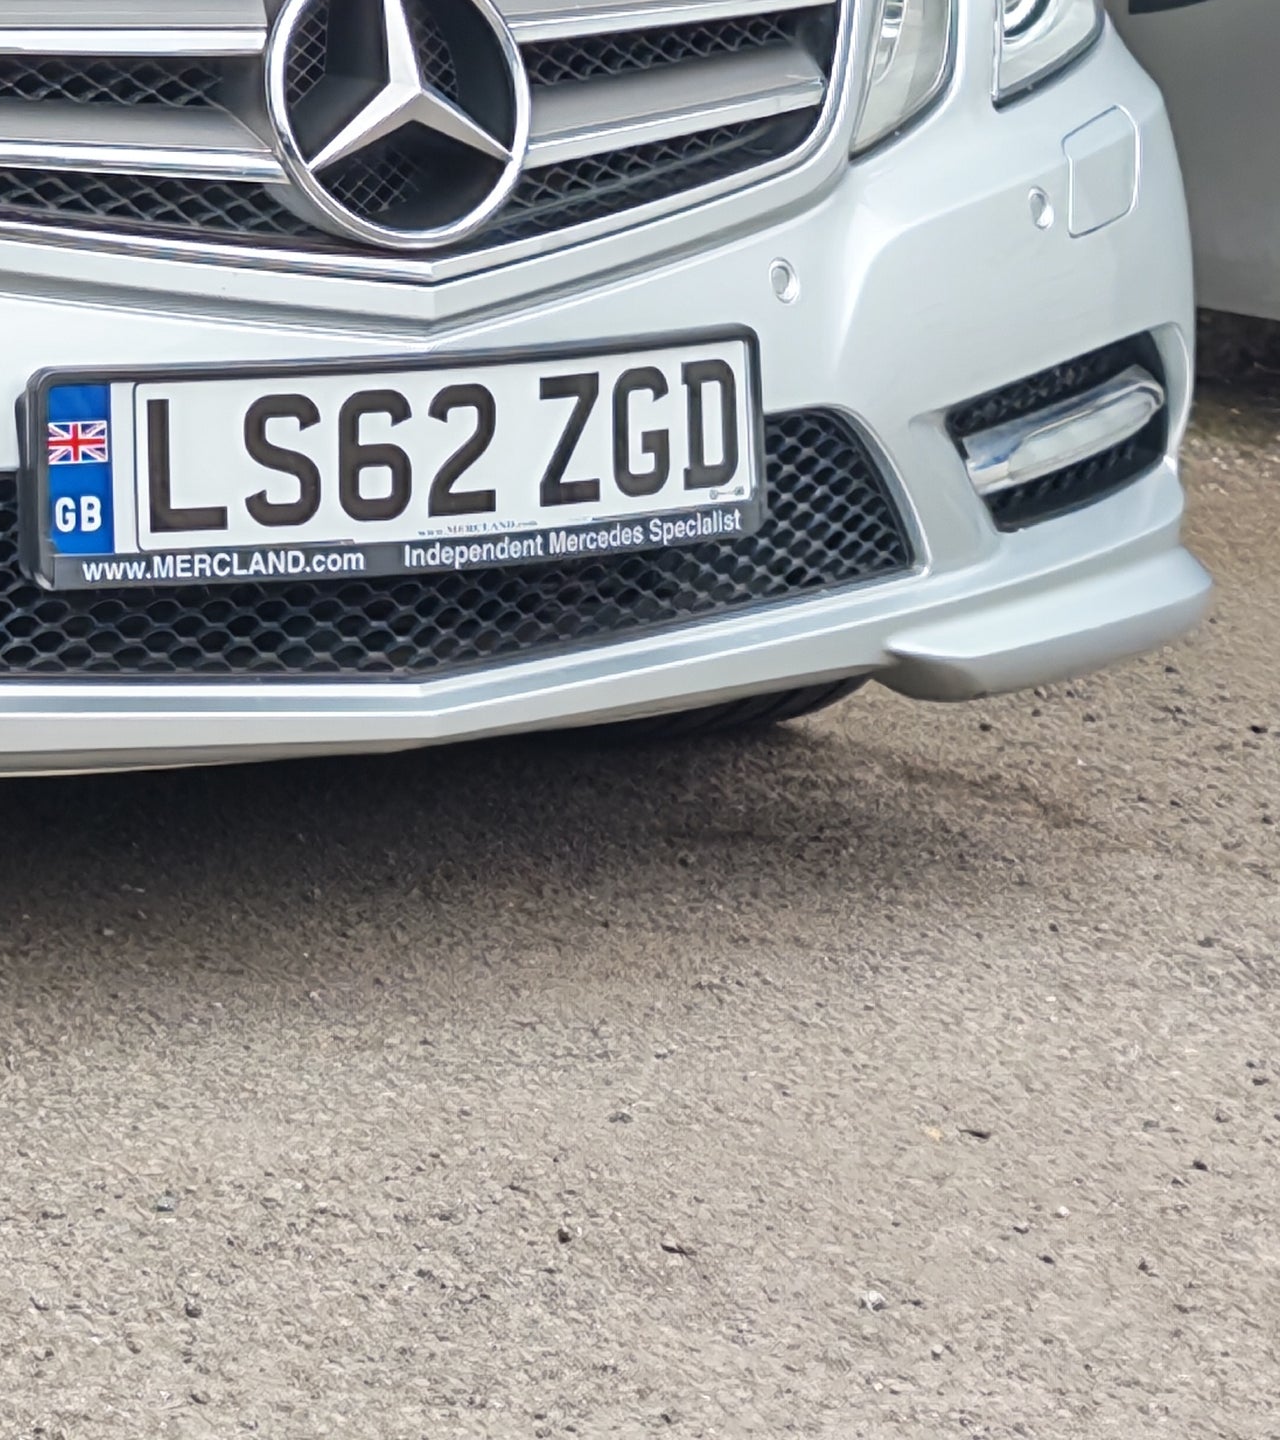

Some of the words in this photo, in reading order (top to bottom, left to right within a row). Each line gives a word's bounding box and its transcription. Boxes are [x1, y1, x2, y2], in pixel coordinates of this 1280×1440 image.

[146, 383, 497, 534] LS62
[539, 359, 739, 508] ZGD
[54, 495, 102, 533] GB
[403, 529, 544, 570] Independent
[548, 519, 644, 555] Mercedes
[648, 507, 743, 548] Specialist
[81, 549, 366, 583] www.MERCLAND.com
